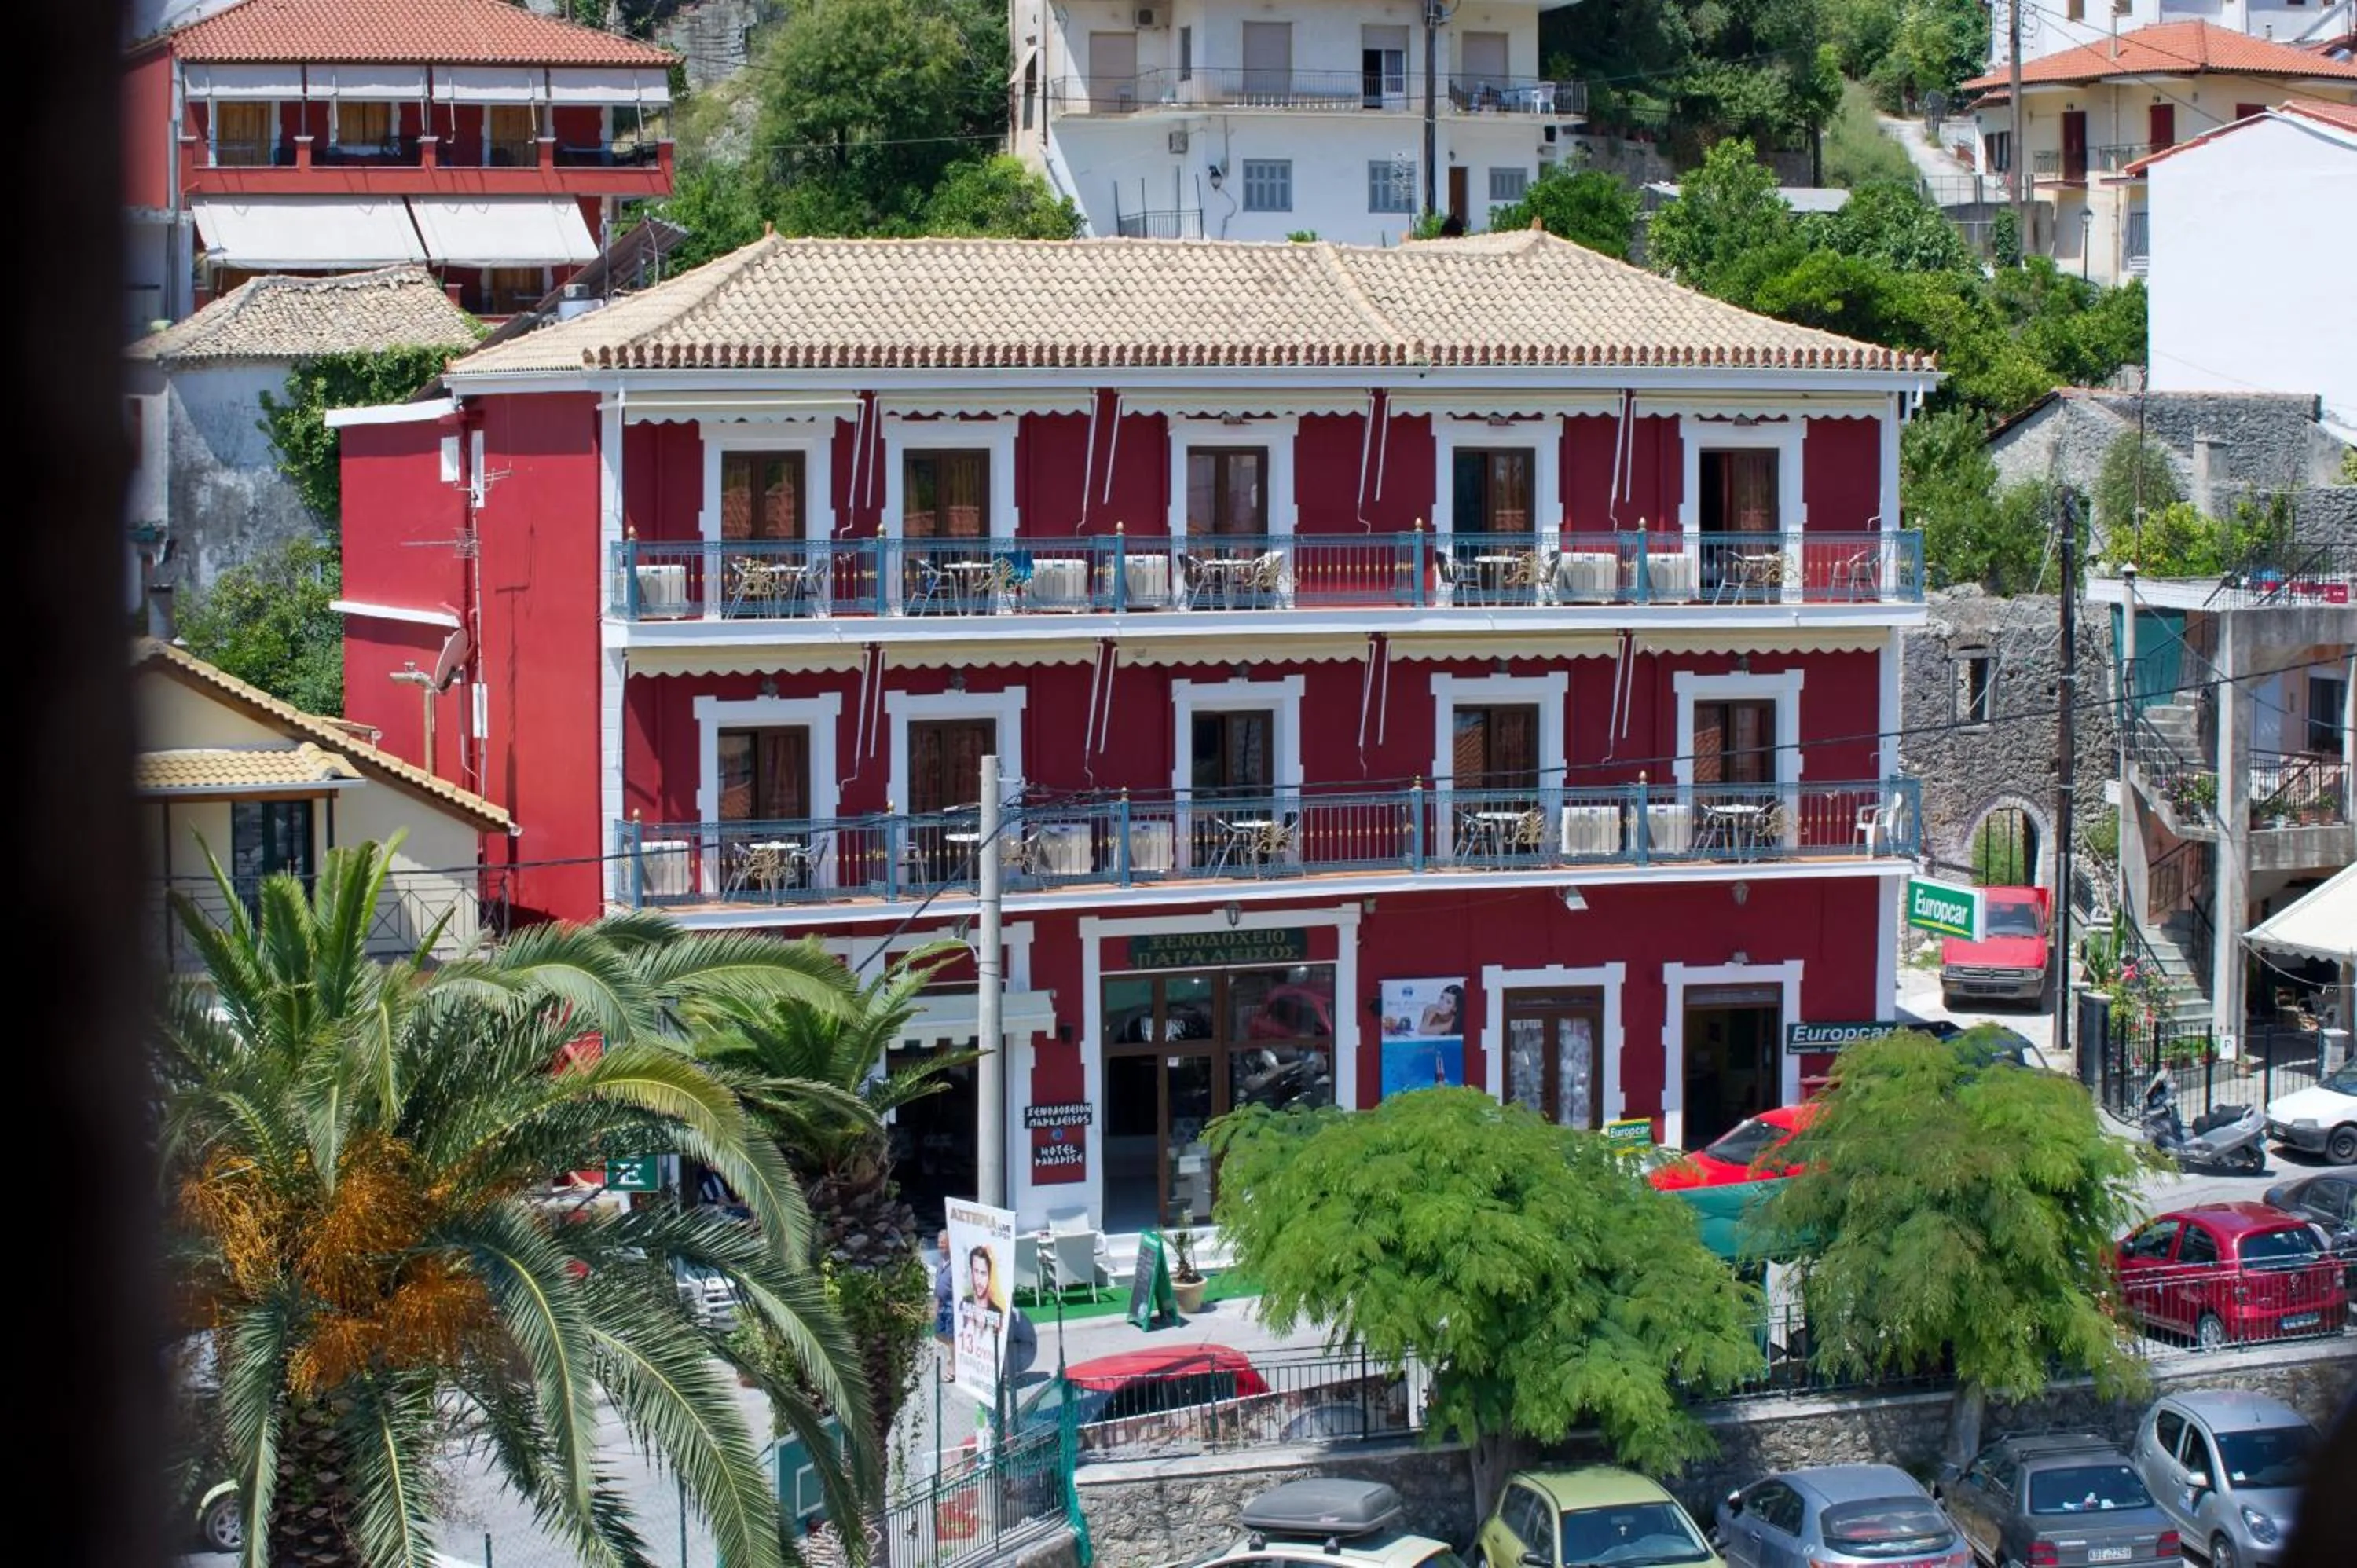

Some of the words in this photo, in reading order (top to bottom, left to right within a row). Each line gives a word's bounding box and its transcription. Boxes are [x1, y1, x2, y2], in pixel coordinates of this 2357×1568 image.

[1915, 888, 1968, 927] Europcar
[1792, 1024, 1893, 1042] Europcar
[1040, 1144, 1077, 1156] HOTEL
[1035, 1153, 1083, 1167] PARADISE
